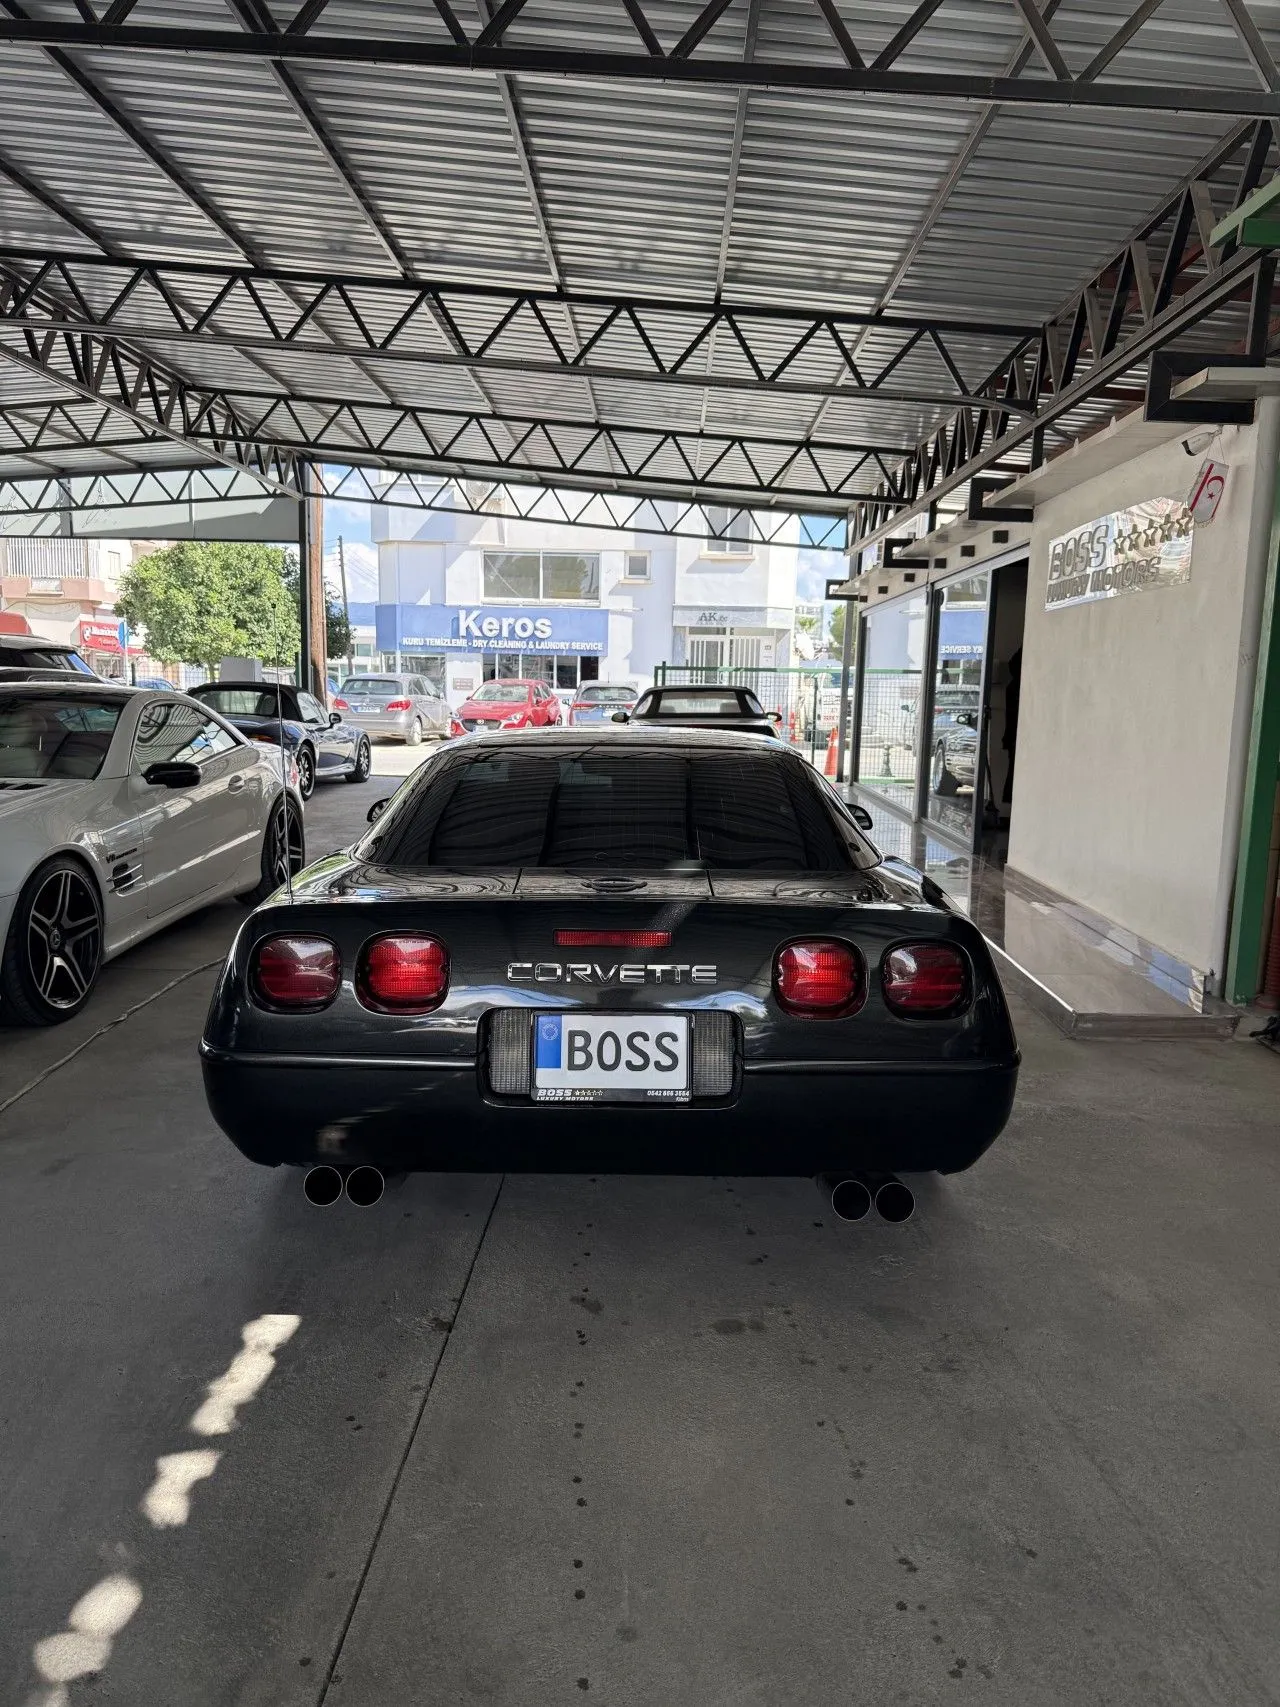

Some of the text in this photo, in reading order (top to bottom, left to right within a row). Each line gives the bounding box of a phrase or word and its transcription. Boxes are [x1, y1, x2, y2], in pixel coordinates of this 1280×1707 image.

[1049, 525, 1109, 580] BOSS
[1090, 556, 1161, 592] MOTORS
[459, 610, 552, 639] Keros
[700, 612, 717, 622] AK
[402, 637, 424, 646] KURU
[425, 637, 467, 647] TEMİZLEME
[473, 640, 488, 648] DRY
[489, 639, 526, 649] CLEANING
[528, 641, 535, 649] &
[536, 641, 570, 650] LAUNDRY
[571, 642, 604, 651] SERVICE
[507, 962, 717, 984] CORVETTE
[567, 1029, 679, 1072] BOSS
[537, 1089, 573, 1097] BOSS
